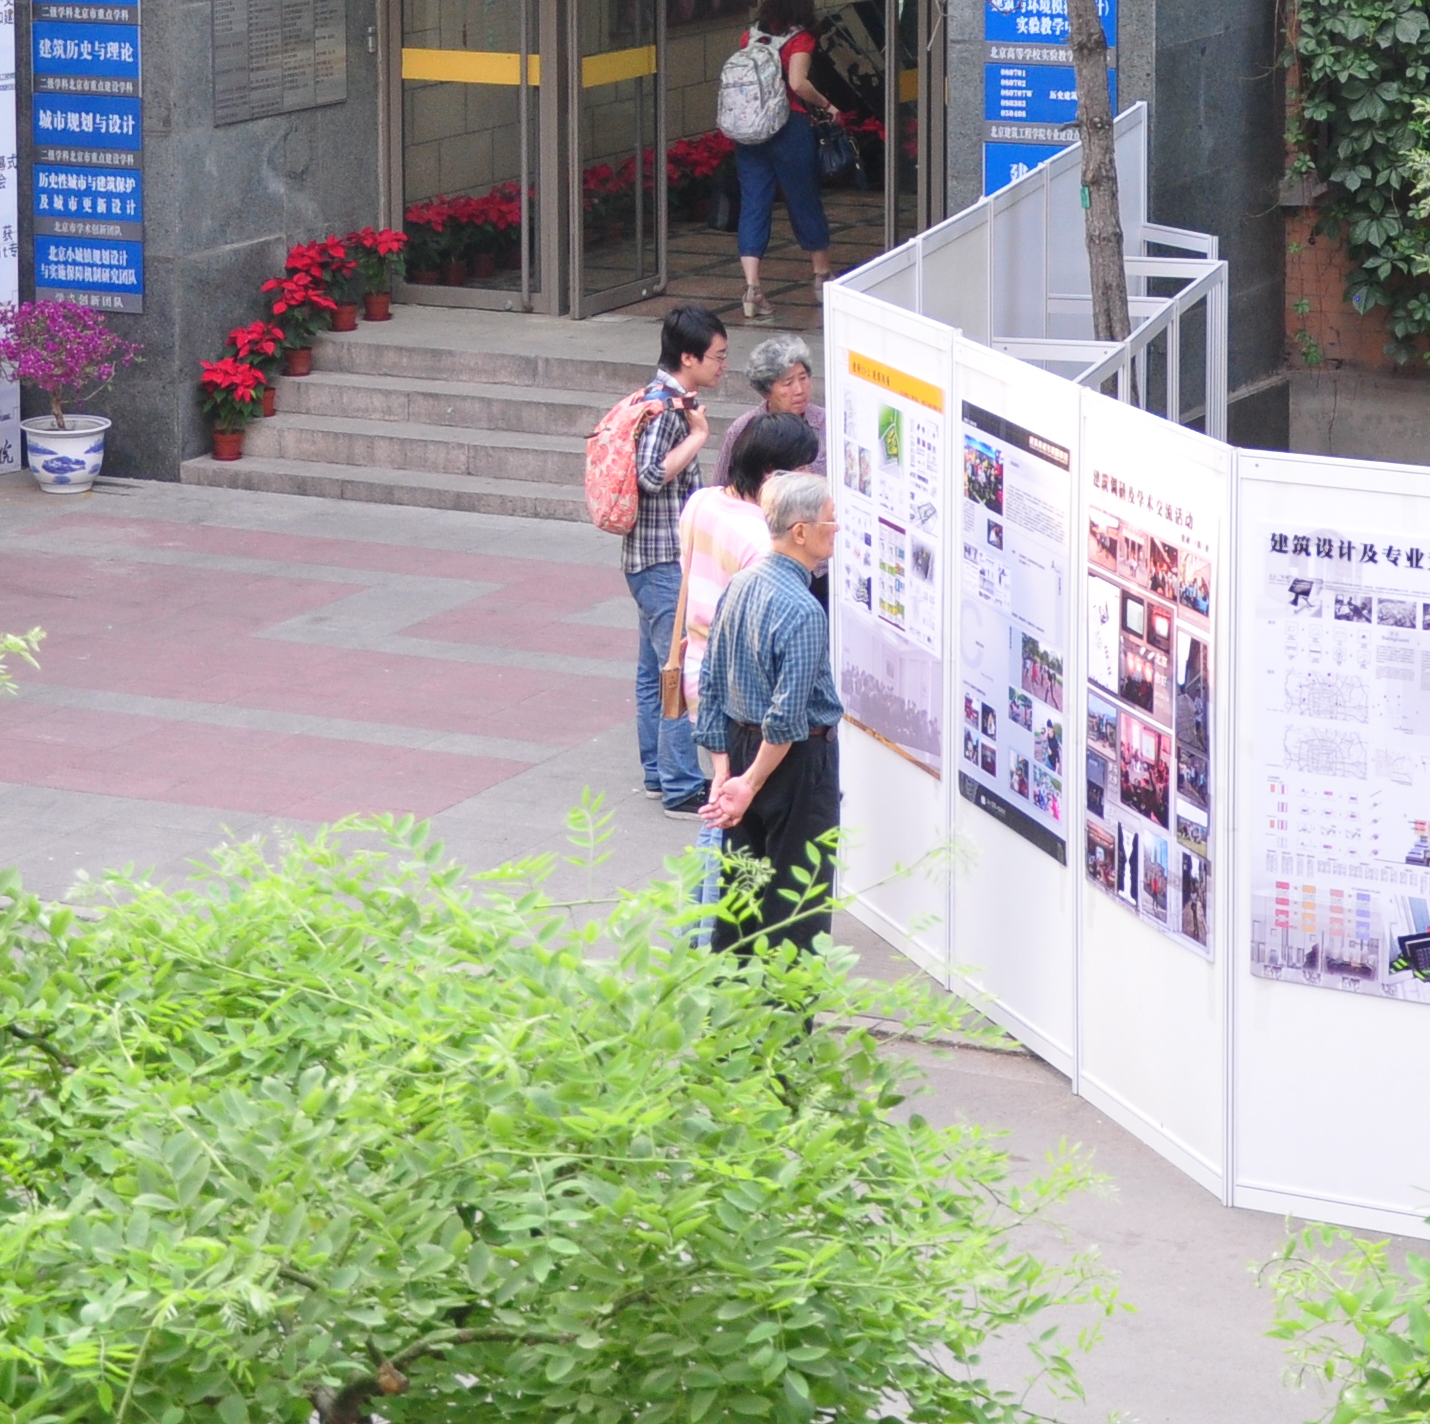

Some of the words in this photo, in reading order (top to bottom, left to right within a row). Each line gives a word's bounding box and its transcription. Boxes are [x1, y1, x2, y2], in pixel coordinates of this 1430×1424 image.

[41, 6, 129, 21] 二级学科北京市重点学科
[38, 38, 134, 63] 建筑历史与理论
[38, 109, 136, 135] 城市规划与设计
[38, 172, 136, 194] 历史性城市与建筑保护
[39, 194, 137, 216] 及城市更新设计
